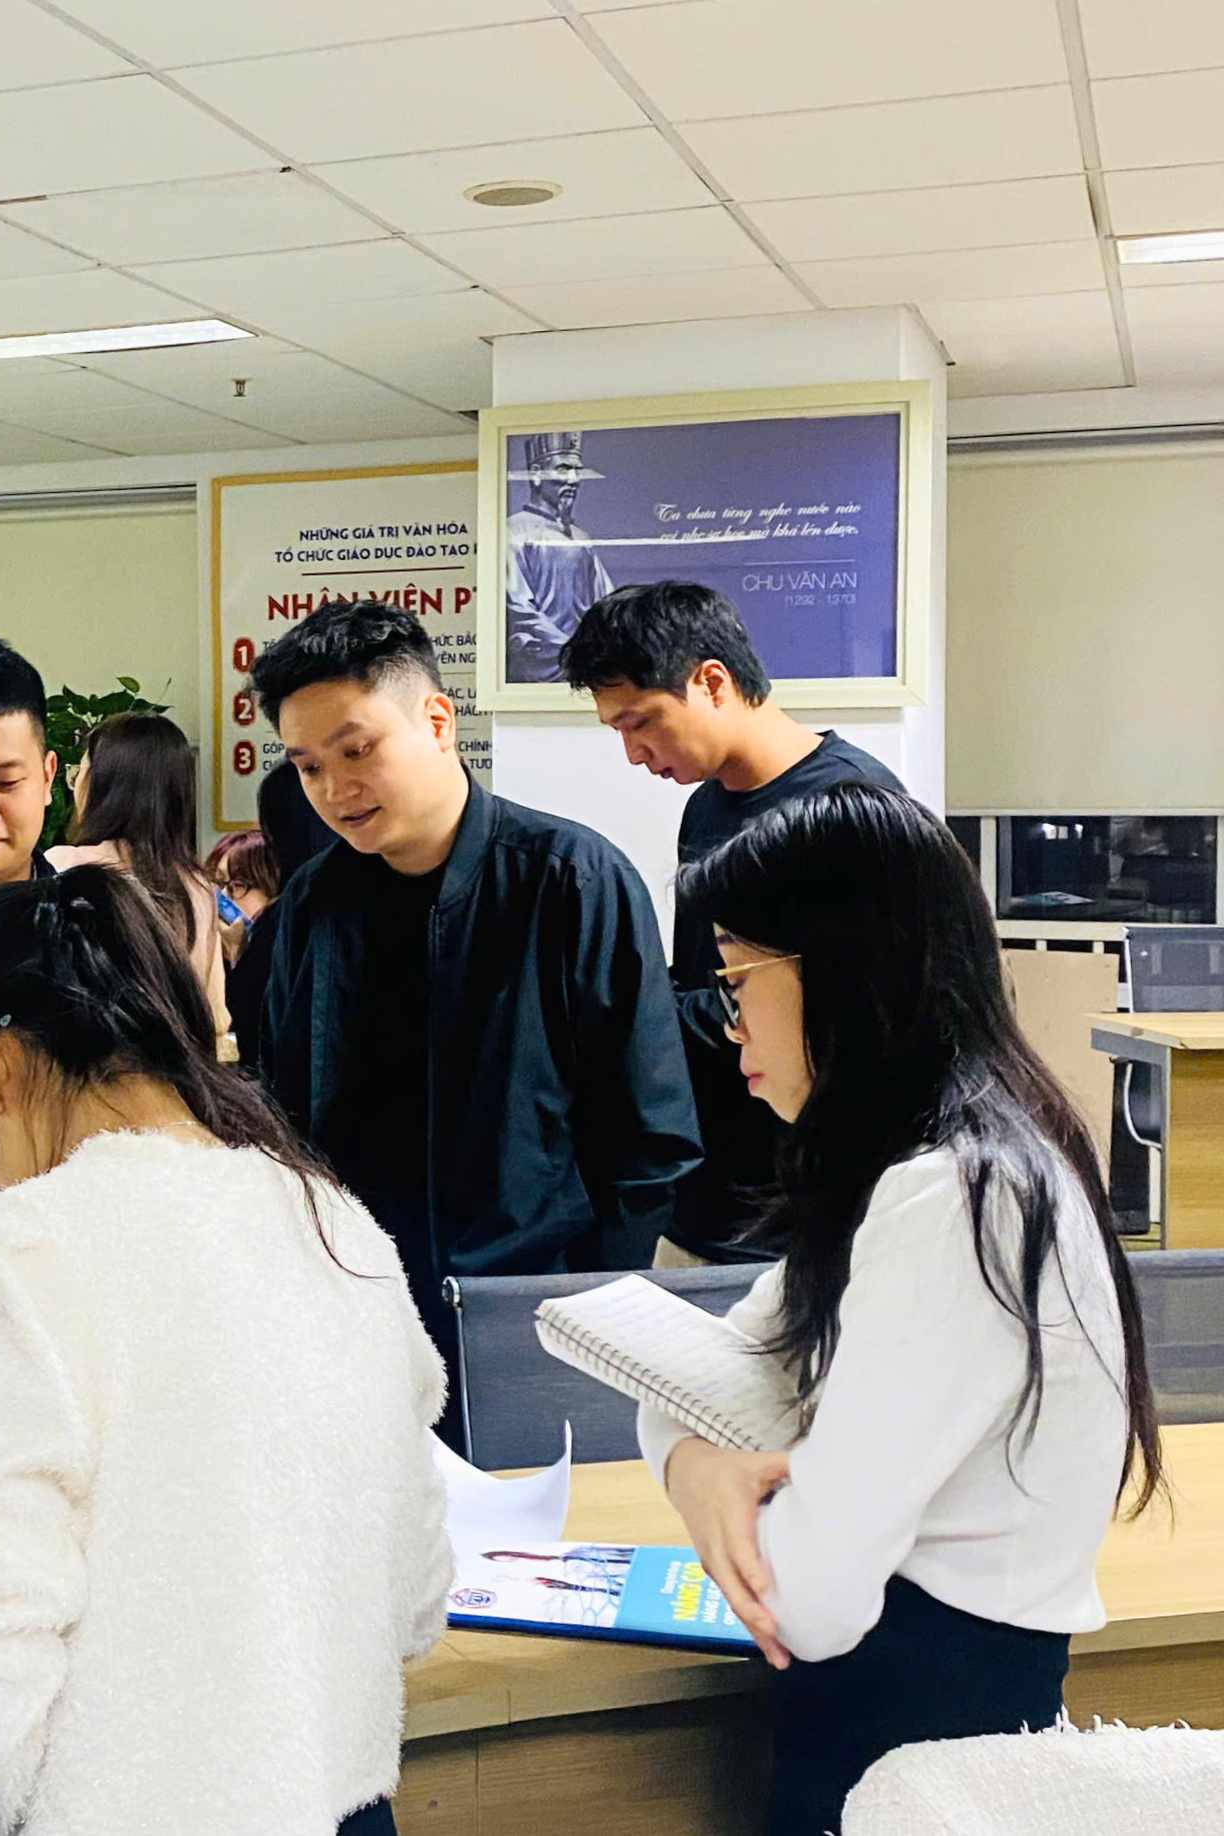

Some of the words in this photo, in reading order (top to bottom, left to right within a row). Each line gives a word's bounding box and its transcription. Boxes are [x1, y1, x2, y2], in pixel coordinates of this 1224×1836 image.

[299, 526, 349, 541] NHỮNG
[352, 524, 375, 539] GIÁ
[402, 522, 432, 537] VĂN
[436, 521, 468, 535] HÓA
[297, 547, 333, 562] CHỨC
[337, 546, 371, 560] GIÁO
[406, 545, 436, 558] ĐÀO
[742, 574, 784, 592] CHU
[787, 571, 826, 590] VĂN
[830, 571, 857, 588] AN
[454, 586, 476, 614] P
[238, 646, 247, 666] 1
[239, 748, 251, 769] 3
